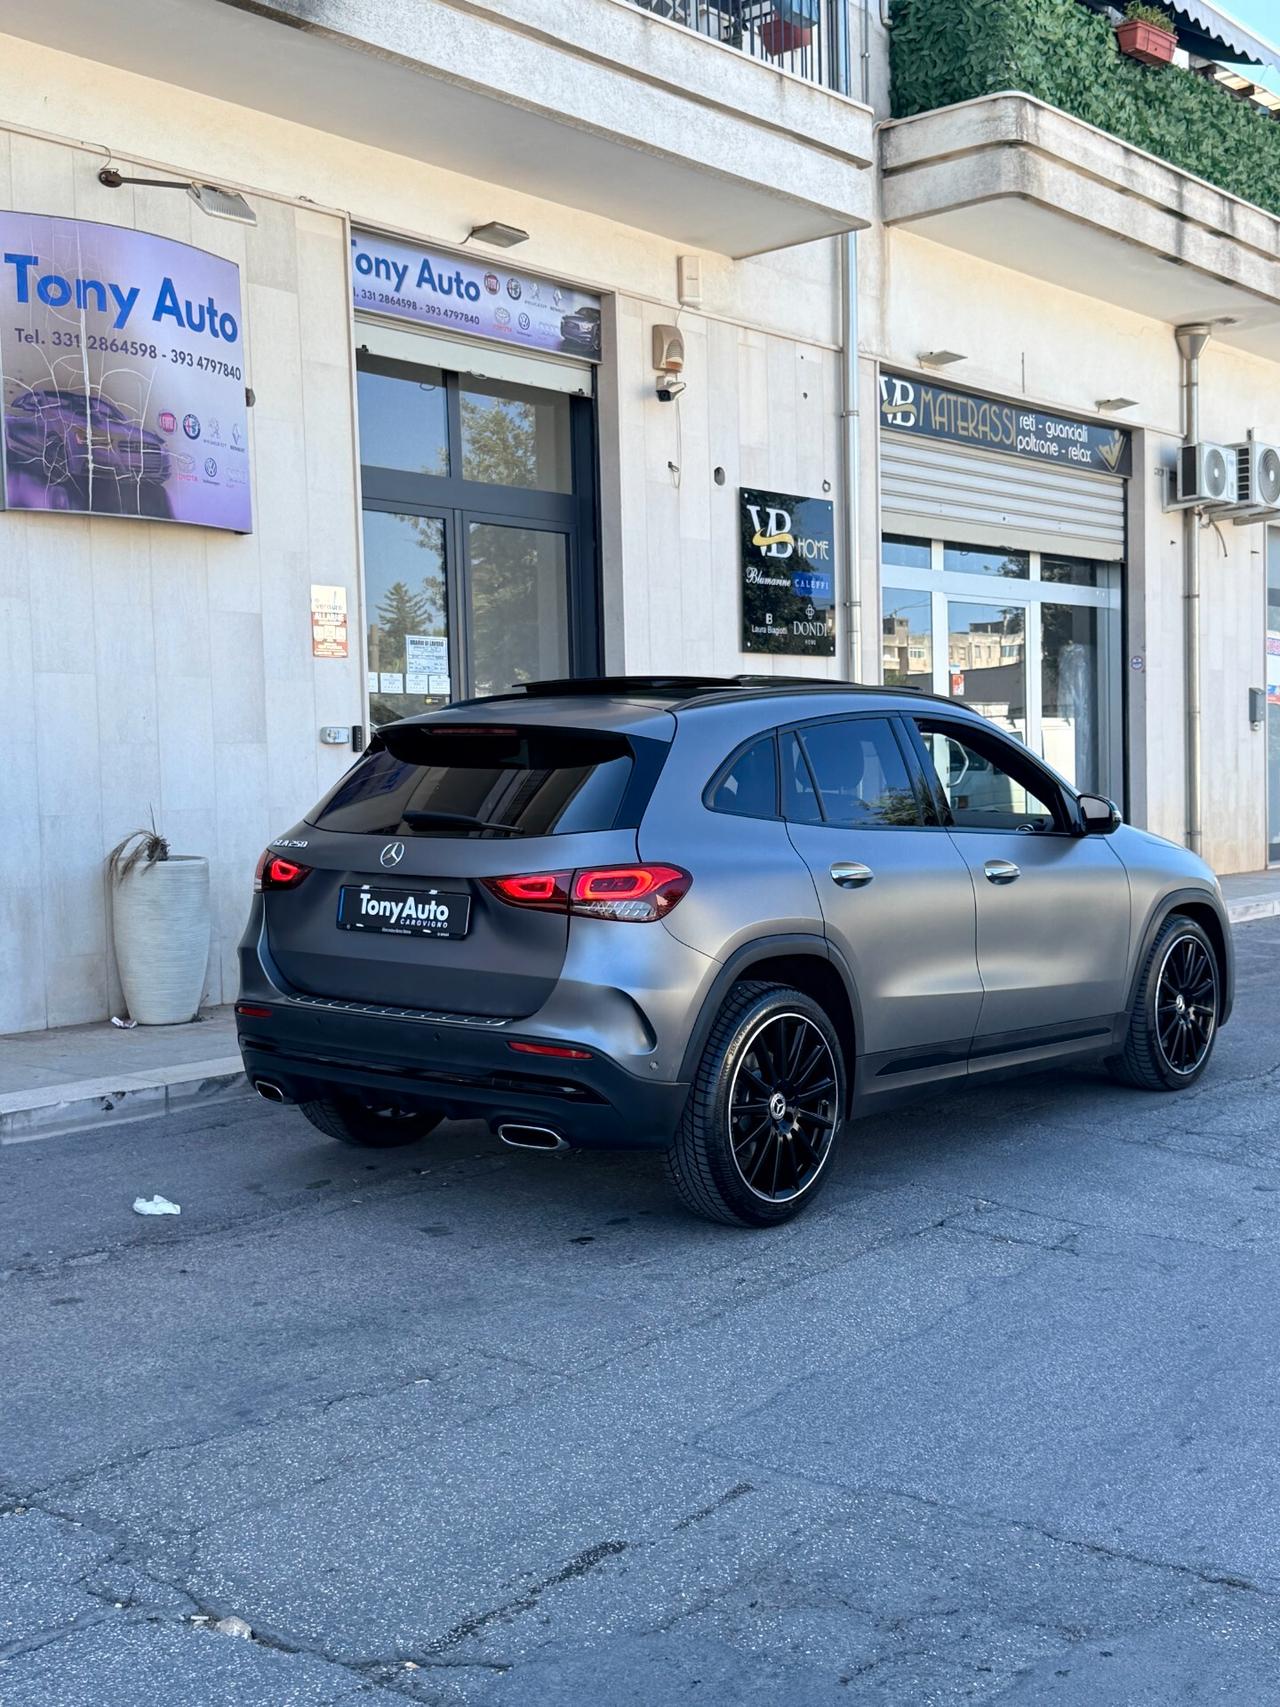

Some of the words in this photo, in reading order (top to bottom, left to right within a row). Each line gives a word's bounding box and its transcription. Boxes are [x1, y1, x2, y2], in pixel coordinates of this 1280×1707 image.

[351, 239, 409, 293] ony
[416, 258, 480, 302] Auto
[4, 253, 140, 330] Tony
[152, 277, 238, 343] Auto
[361, 289, 376, 301] 331
[378, 293, 417, 310] 2864598
[425, 304, 441, 316] 393
[443, 308, 480, 325] 4797840
[14, 327, 45, 345] Tel.
[52, 331, 80, 349] 331
[87, 335, 157, 359] 2864598
[170, 349, 194, 367] 393
[196, 356, 242, 381] 4797840
[919, 386, 1017, 447] MATERASSI
[1019, 414, 1036, 431] reti
[1045, 421, 1088, 443] guanciali
[1017, 433, 1059, 456] poltrone
[1068, 443, 1092, 463] relax
[746, 504, 795, 558] VB
[797, 537, 829, 560] HOME
[766, 613, 773, 625] B
[793, 621, 828, 637] DONDI
[360, 893, 449, 924] TonyAuto
[400, 918, 449, 929] CAROVIGNO
